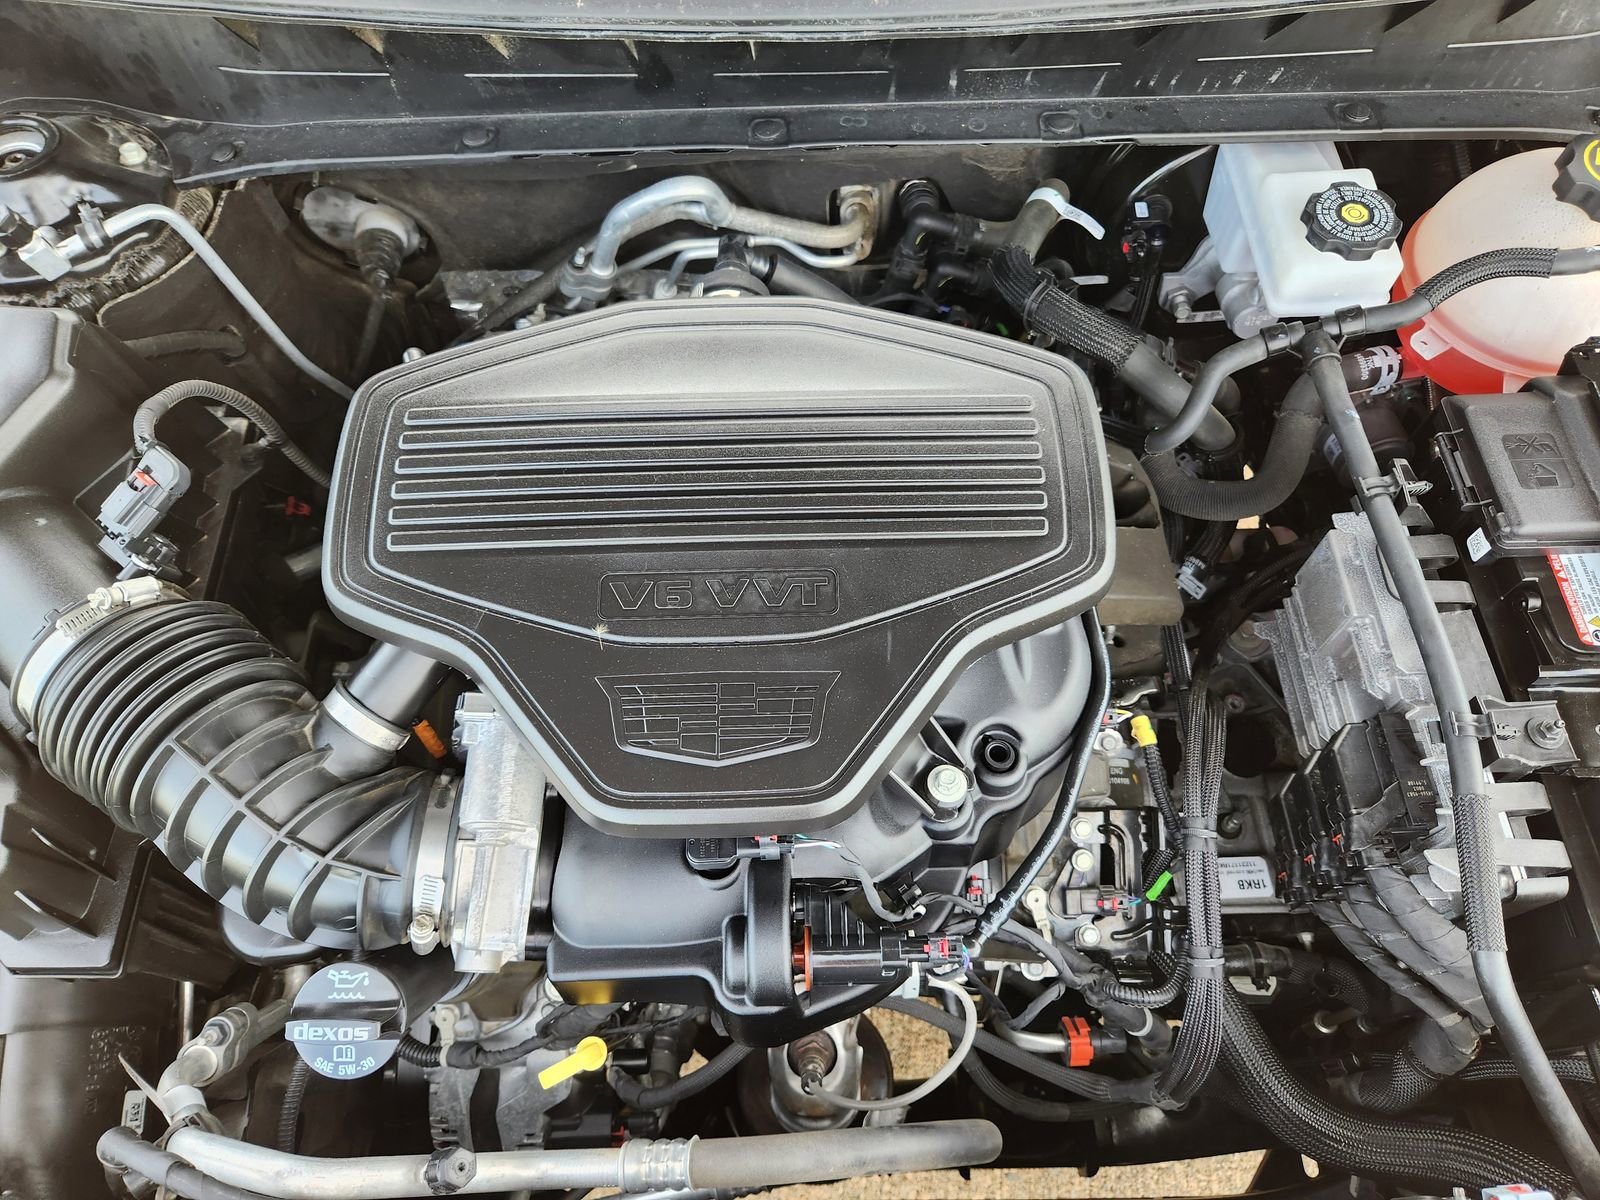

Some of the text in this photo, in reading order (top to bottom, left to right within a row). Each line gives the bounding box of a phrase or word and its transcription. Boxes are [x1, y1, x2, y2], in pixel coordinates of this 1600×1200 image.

[609, 577, 829, 610] V6 VVT
[1237, 879, 1267, 890] 1RKB
[293, 1022, 372, 1042] dexos
[314, 1056, 376, 1076] SAE 5W-30
